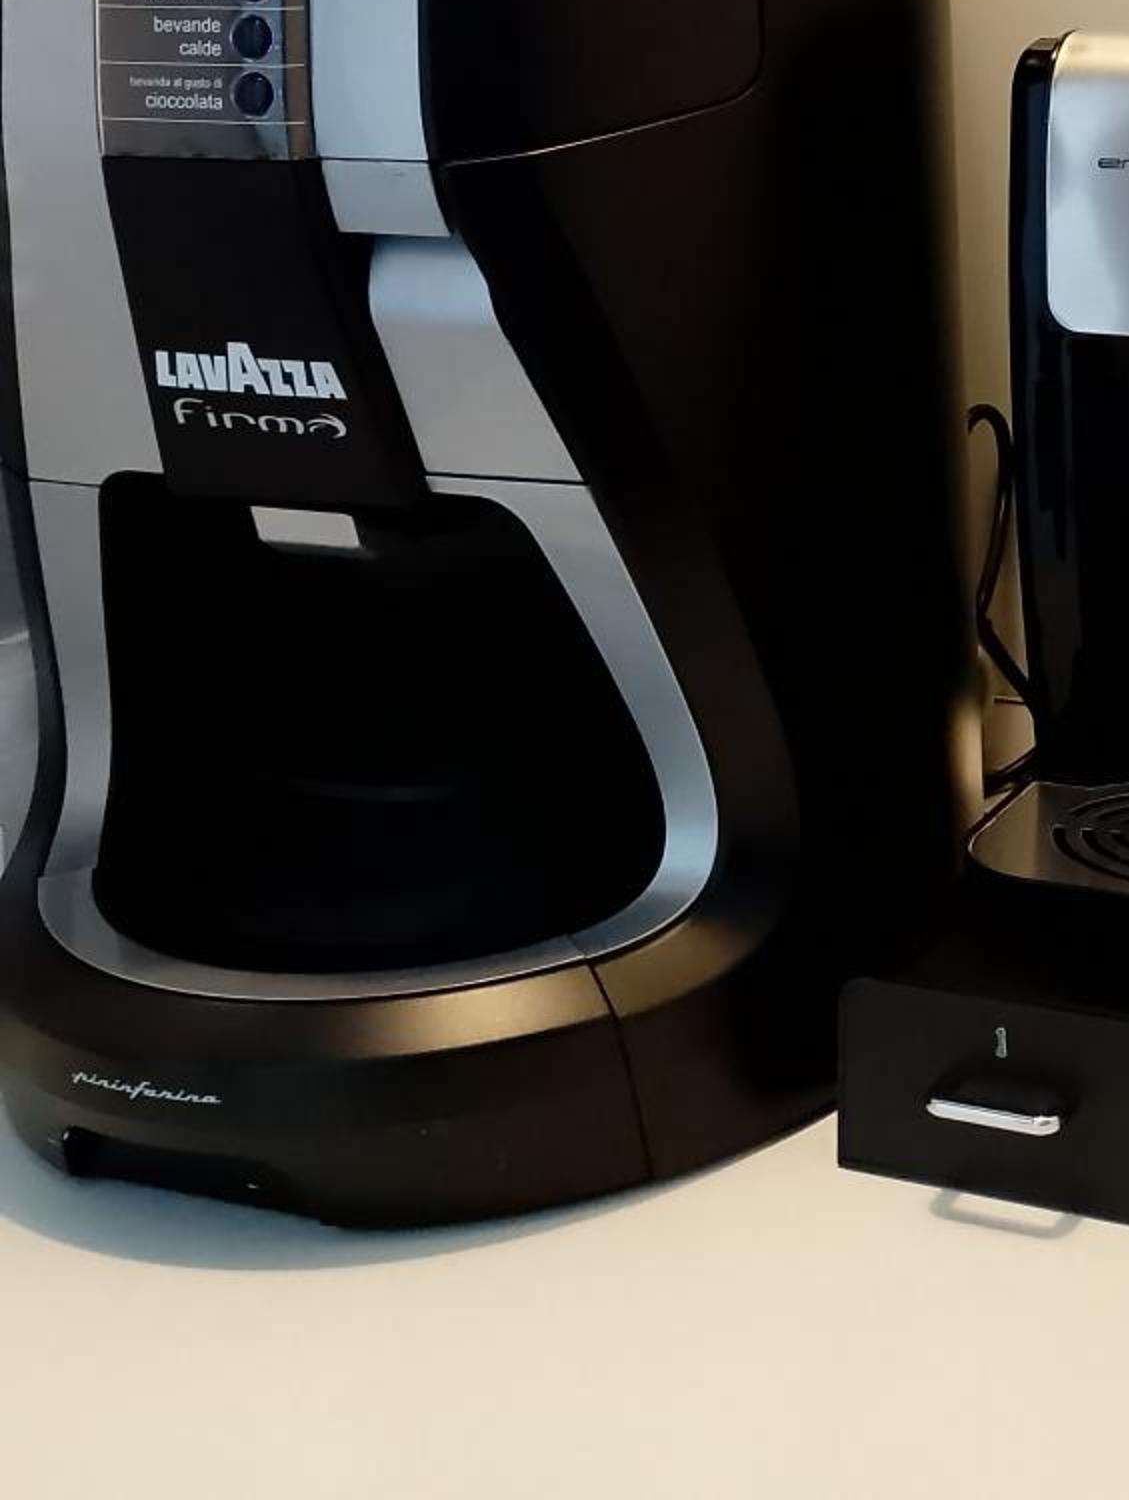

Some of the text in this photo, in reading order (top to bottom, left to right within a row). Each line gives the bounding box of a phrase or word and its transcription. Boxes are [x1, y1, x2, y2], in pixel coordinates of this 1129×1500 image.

[153, 16, 221, 33] bevande
[179, 40, 222, 56] calde
[145, 92, 223, 110] cioccolata
[155, 341, 348, 399] LAVAZZA
[994, 1027, 1008, 1059] 1
[71, 1071, 223, 1104] pininfarina
